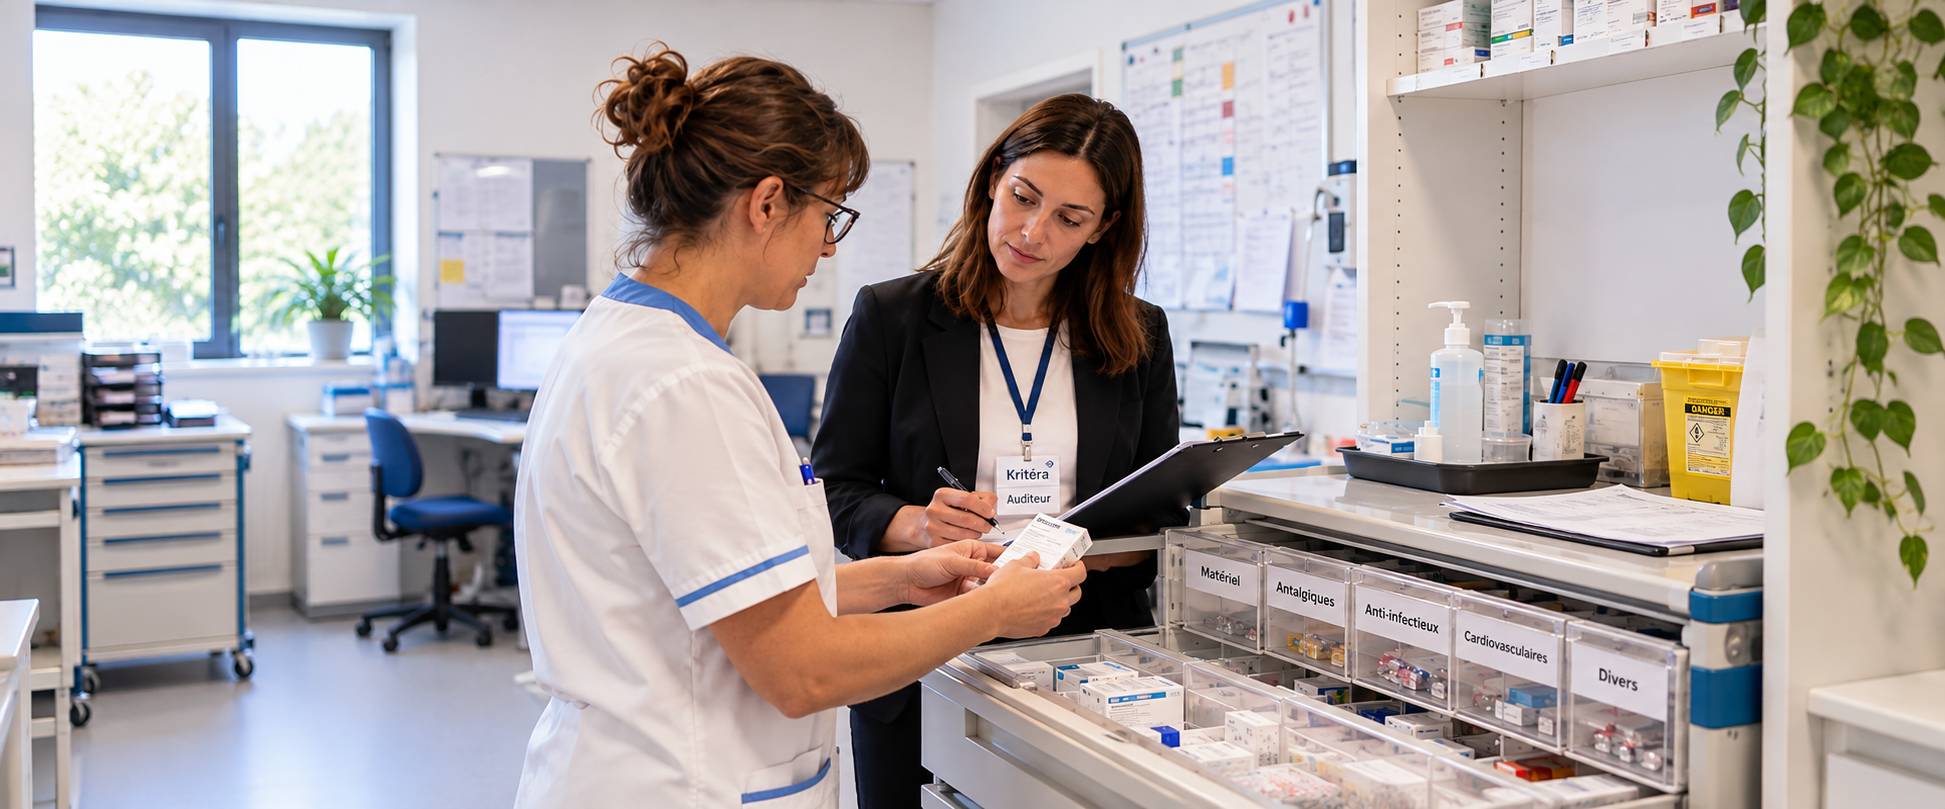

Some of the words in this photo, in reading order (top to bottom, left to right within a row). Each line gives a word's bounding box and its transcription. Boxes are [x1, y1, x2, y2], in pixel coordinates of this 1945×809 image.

[1006, 493, 1051, 504] Auditeur
[1201, 565, 1241, 587] Matériel
[1276, 581, 1335, 607] Antalgiques
[1364, 603, 1439, 634] Anti-infectieux
[1464, 630, 1548, 664] Cardiovasculaires
[1598, 667, 1639, 692] Divers
